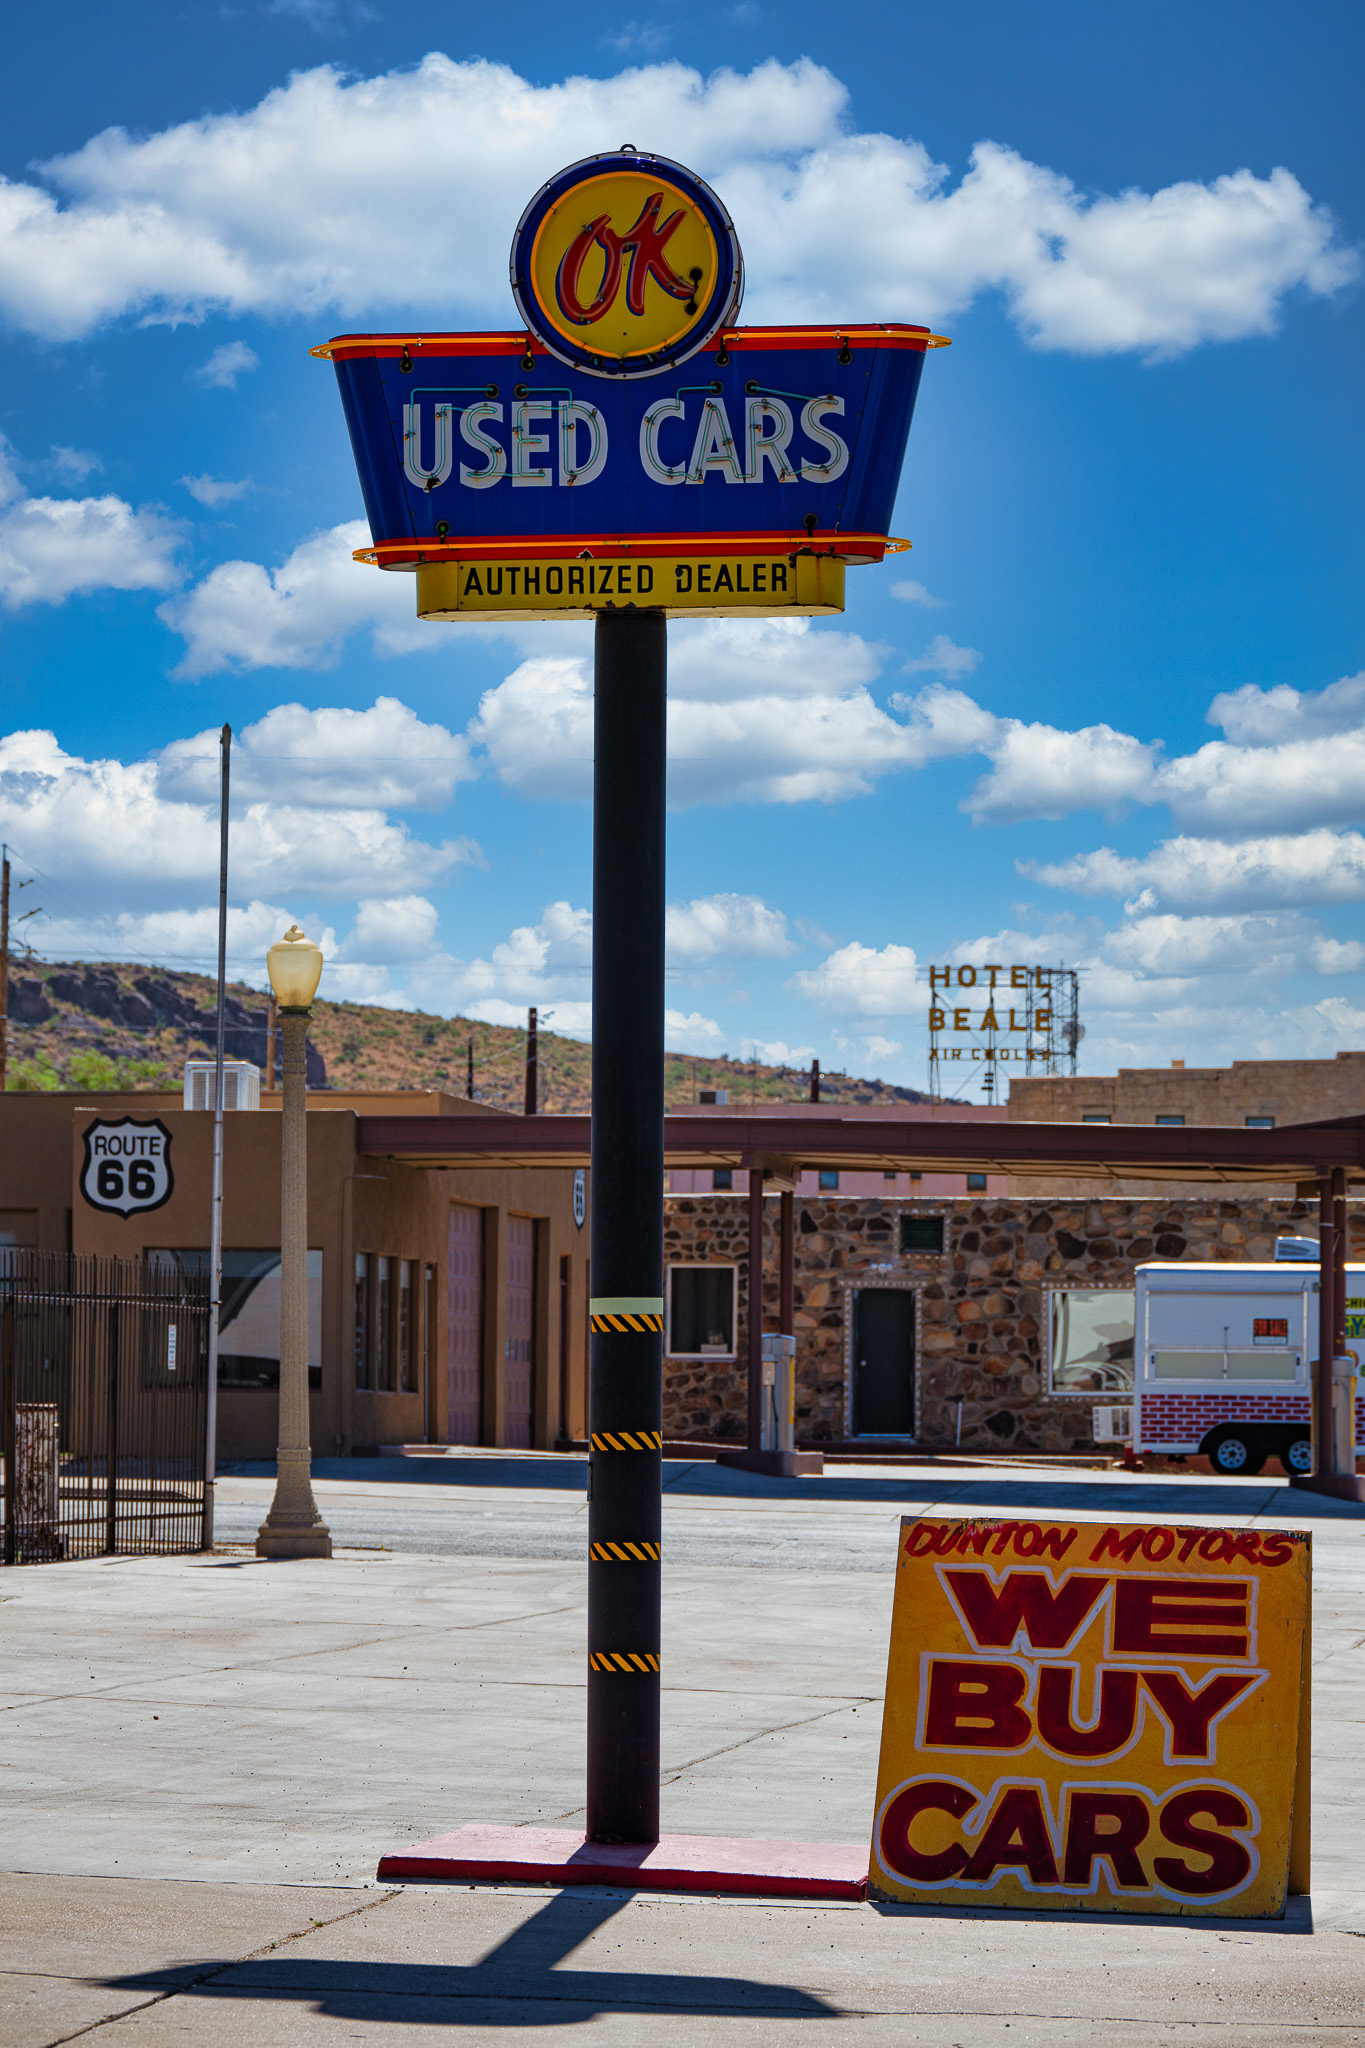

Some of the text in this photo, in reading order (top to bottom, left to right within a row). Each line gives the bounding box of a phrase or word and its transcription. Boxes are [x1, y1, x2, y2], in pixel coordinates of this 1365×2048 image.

[556, 192, 700, 326] OK
[402, 395, 850, 491] USED CARS
[463, 563, 789, 597] AUTHORIZED DEALER
[929, 965, 1052, 988] HOTEL
[929, 1008, 1052, 1031] BEALE
[929, 1048, 962, 1060] AIR
[94, 1135, 161, 1156] ROUTE
[97, 1159, 156, 1200] 66
[904, 1522, 1300, 1567] DUNTON MOTORS
[941, 1568, 1250, 1659] WE
[922, 1659, 1260, 1759] BUY
[877, 1778, 1255, 1897] CARS
